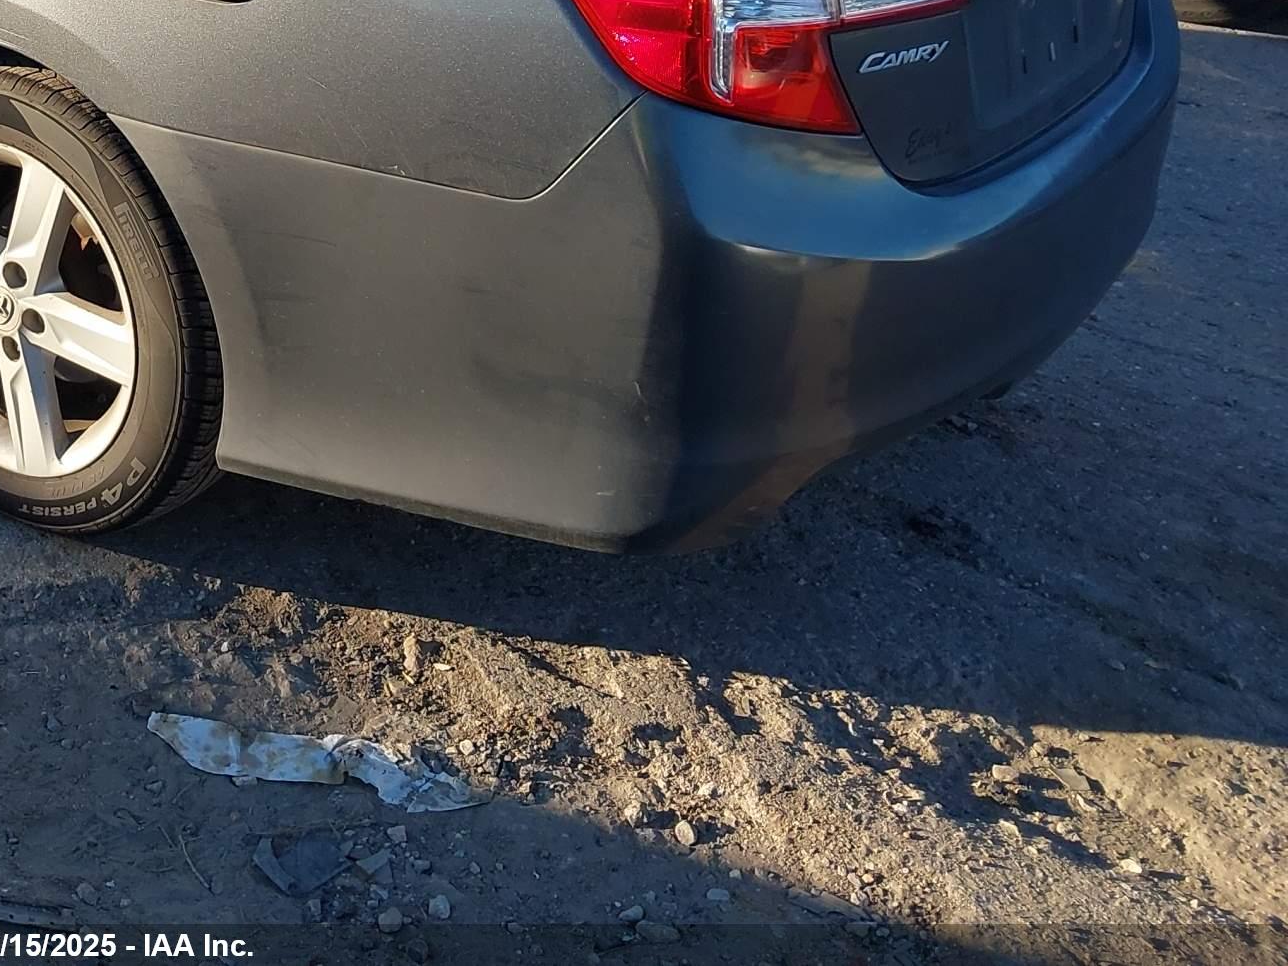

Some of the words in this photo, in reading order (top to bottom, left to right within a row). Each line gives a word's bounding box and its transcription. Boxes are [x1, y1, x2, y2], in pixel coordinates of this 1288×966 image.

[858, 40, 950, 74] CAMRY
[113, 201, 161, 282] PIRELLI
[18, 497, 98, 517] PERSIST
